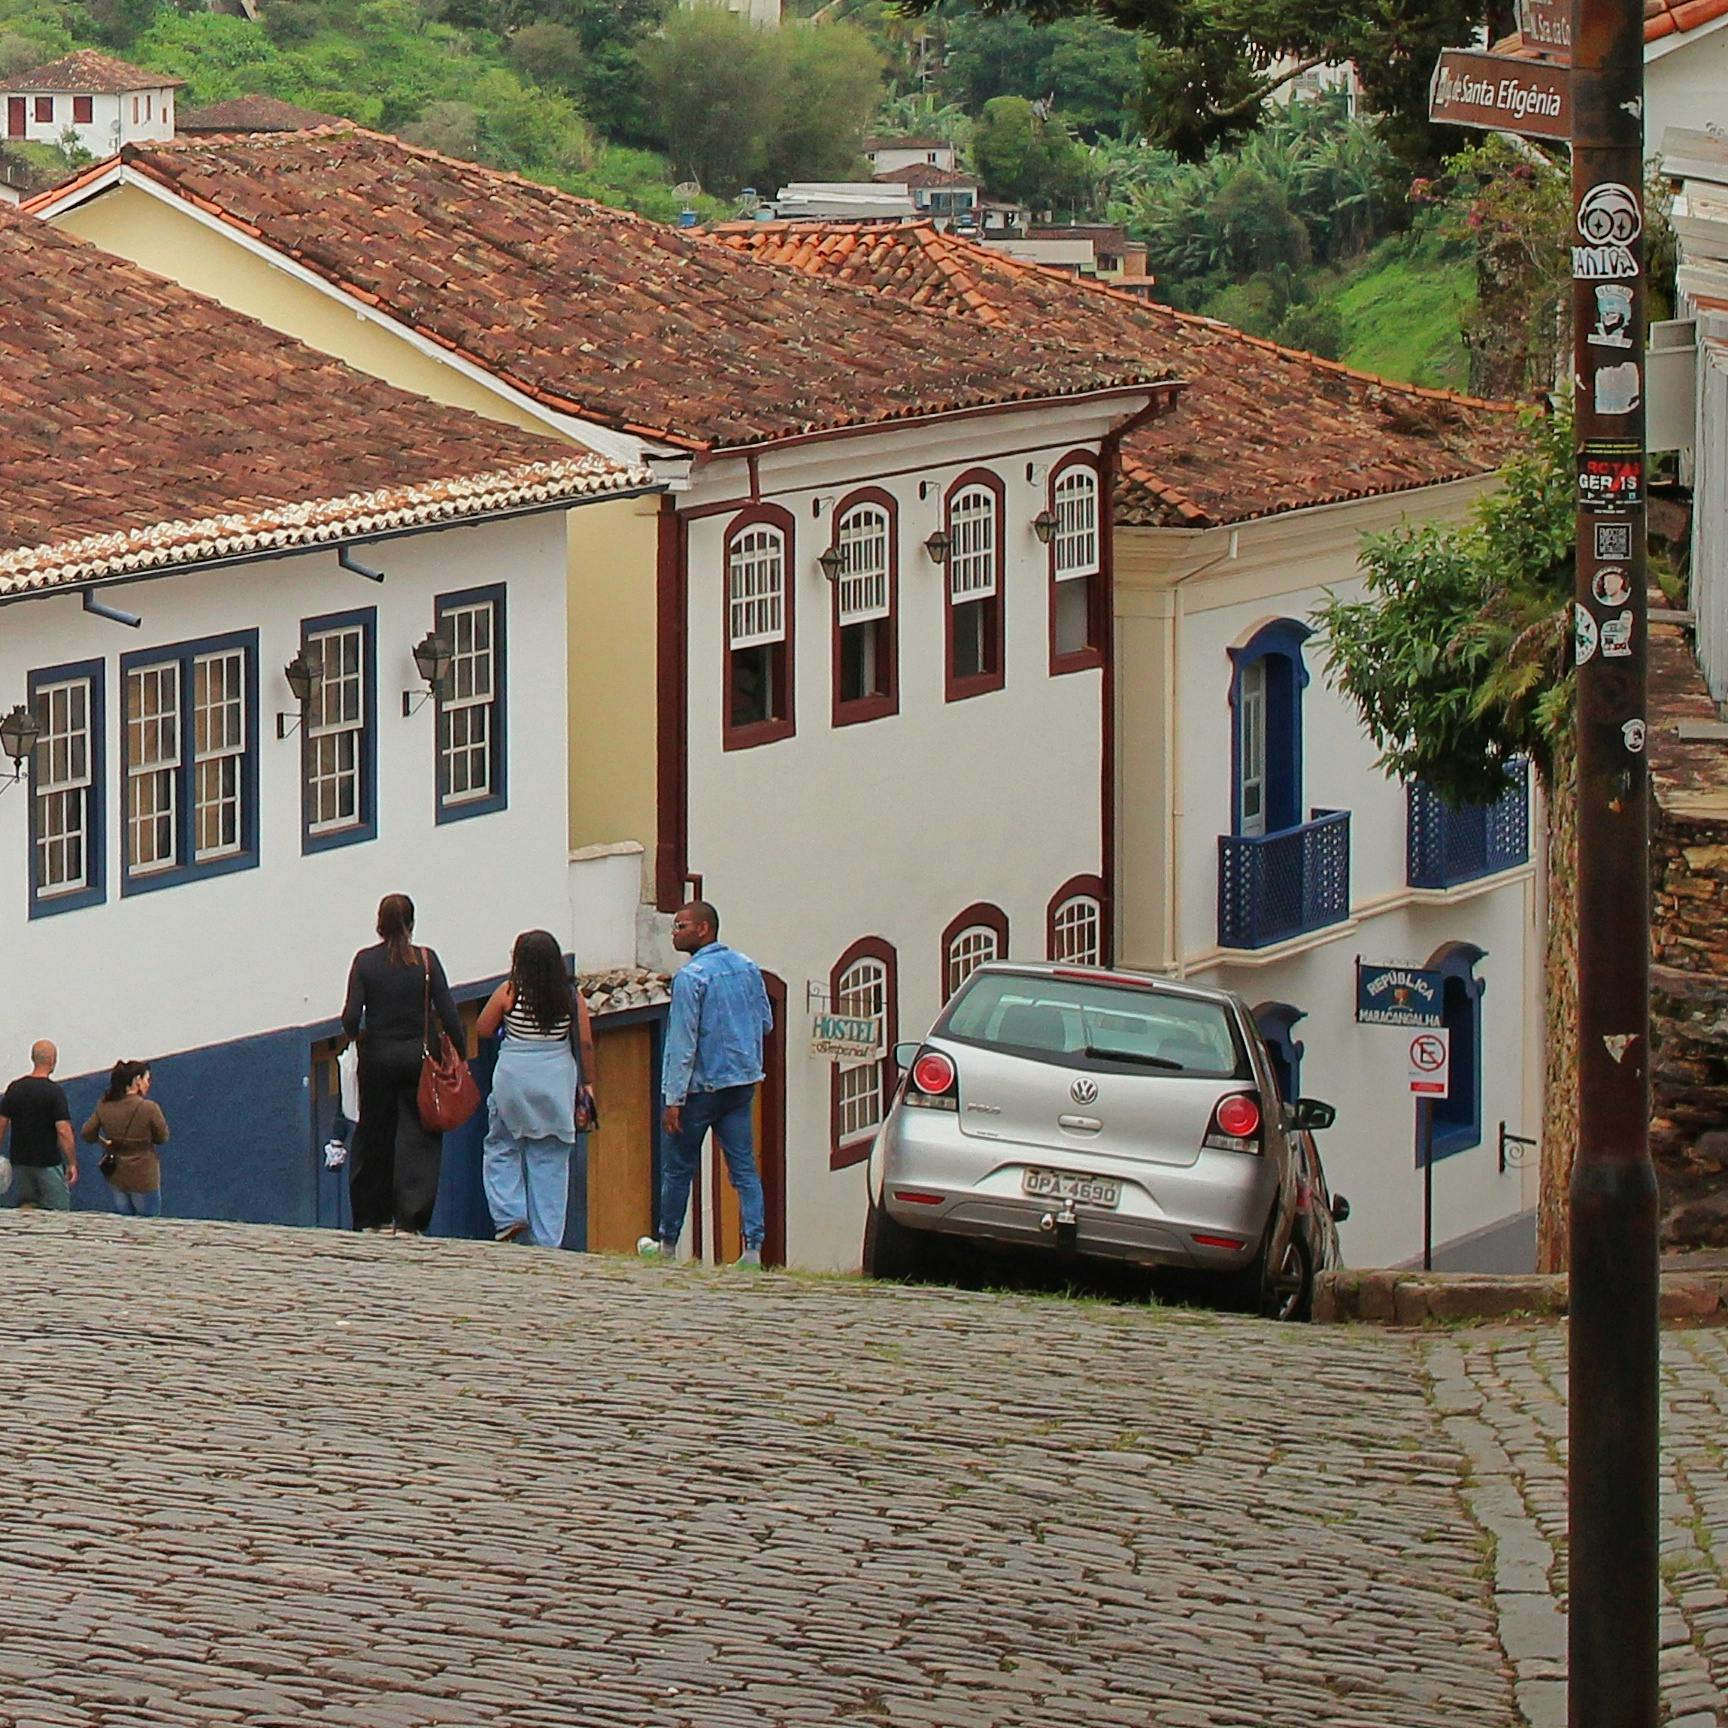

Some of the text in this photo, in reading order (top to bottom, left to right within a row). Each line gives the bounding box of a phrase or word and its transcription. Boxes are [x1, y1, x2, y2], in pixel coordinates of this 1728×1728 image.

[1462, 74, 1494, 107] Santa
[1496, 79, 1562, 119] Efigênia
[1366, 970, 1435, 1001] REPÚBLICA
[813, 1016, 875, 1044] HOSTEL
[1359, 1009, 1441, 1027] MARACANGALHA
